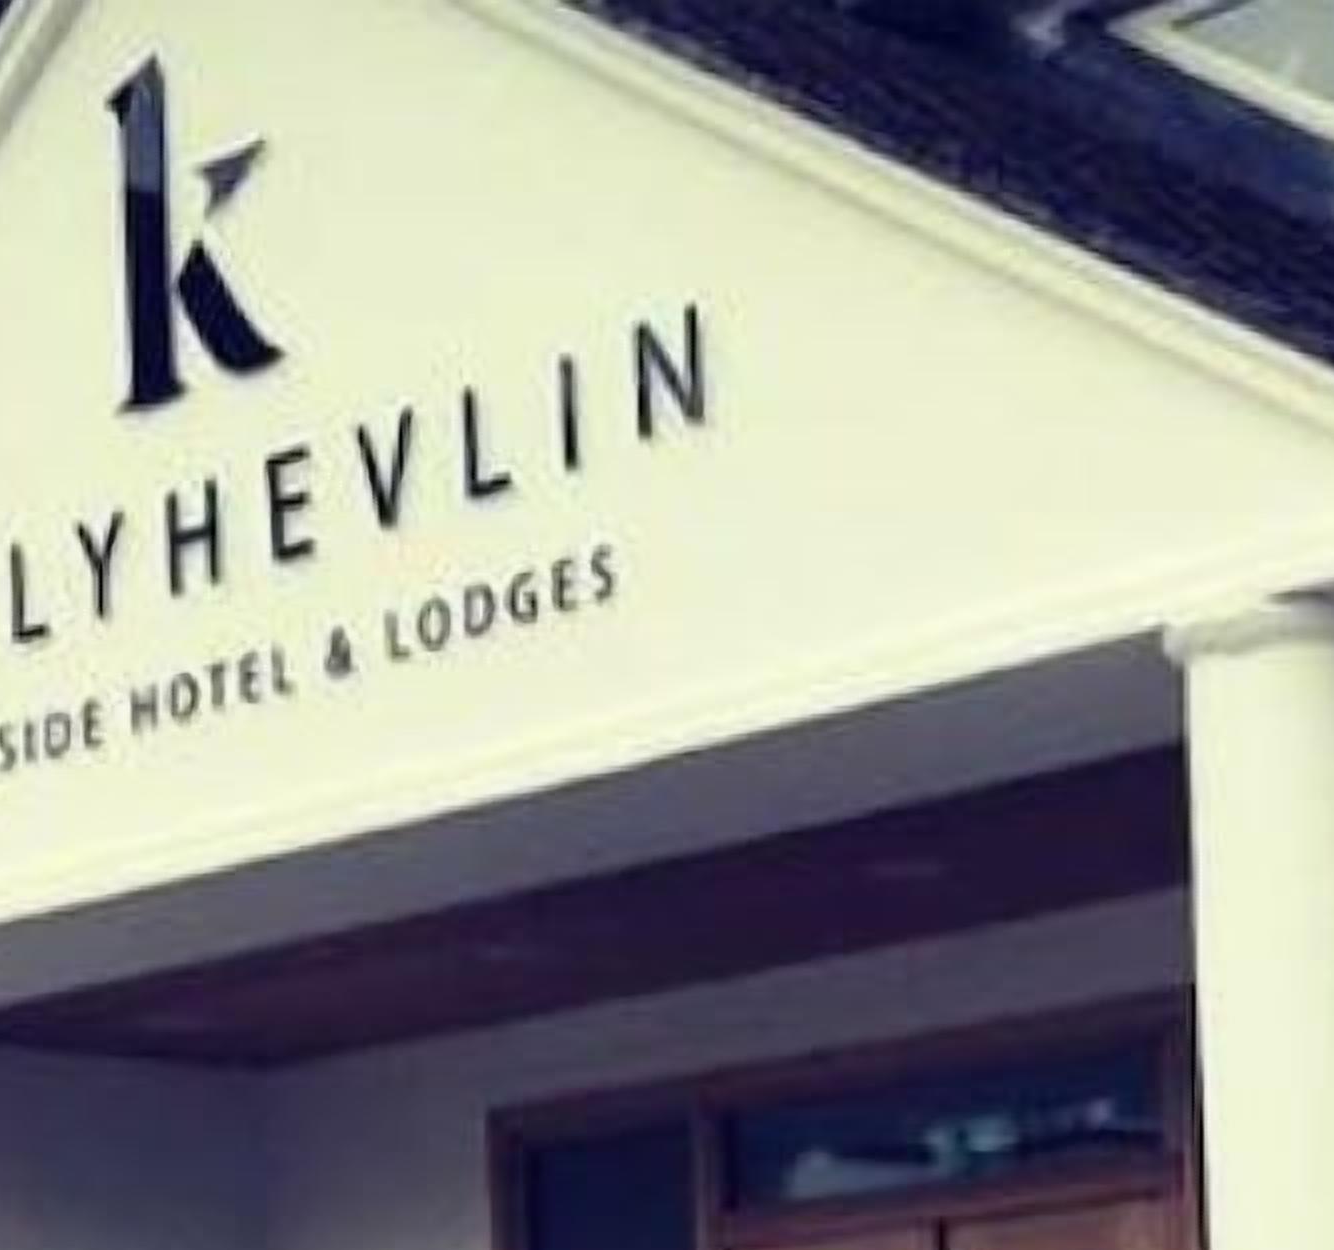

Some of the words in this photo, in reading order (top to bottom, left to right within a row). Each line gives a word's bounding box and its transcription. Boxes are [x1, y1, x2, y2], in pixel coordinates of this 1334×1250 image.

[129, 646, 294, 735] HOTEL
[323, 627, 353, 677] &
[385, 544, 617, 662] LODGES
